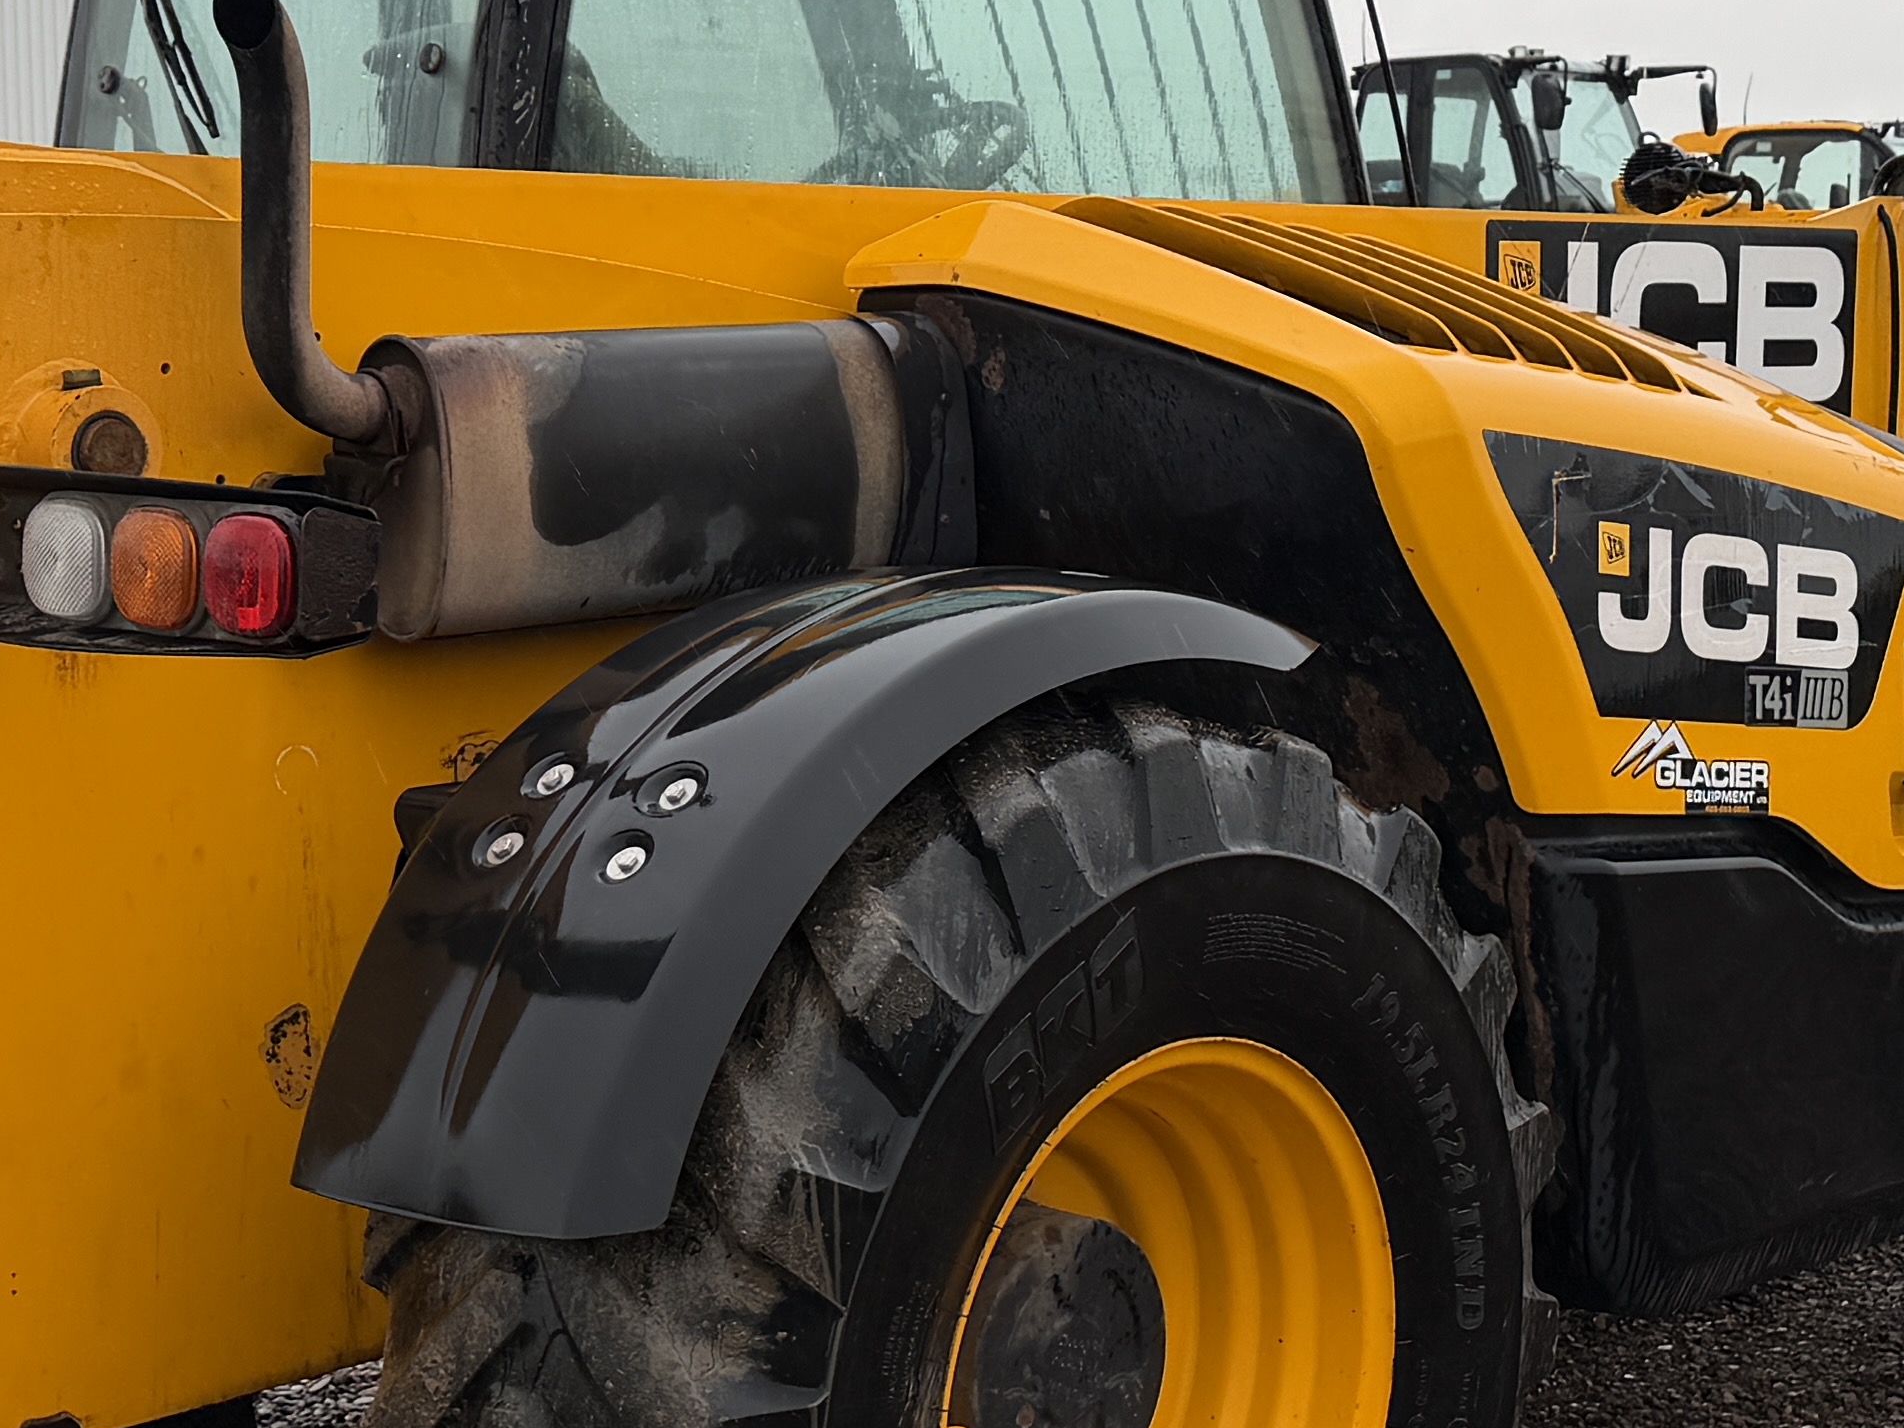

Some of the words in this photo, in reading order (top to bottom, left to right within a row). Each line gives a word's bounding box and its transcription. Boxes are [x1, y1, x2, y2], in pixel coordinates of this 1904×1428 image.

[1598, 527, 1859, 669] JCB
[1749, 674, 1795, 720] T4i
[1656, 759, 1769, 789] GLACIER
[1686, 789, 1755, 805] EQUIPMENT
[983, 907, 1145, 1157] BKT
